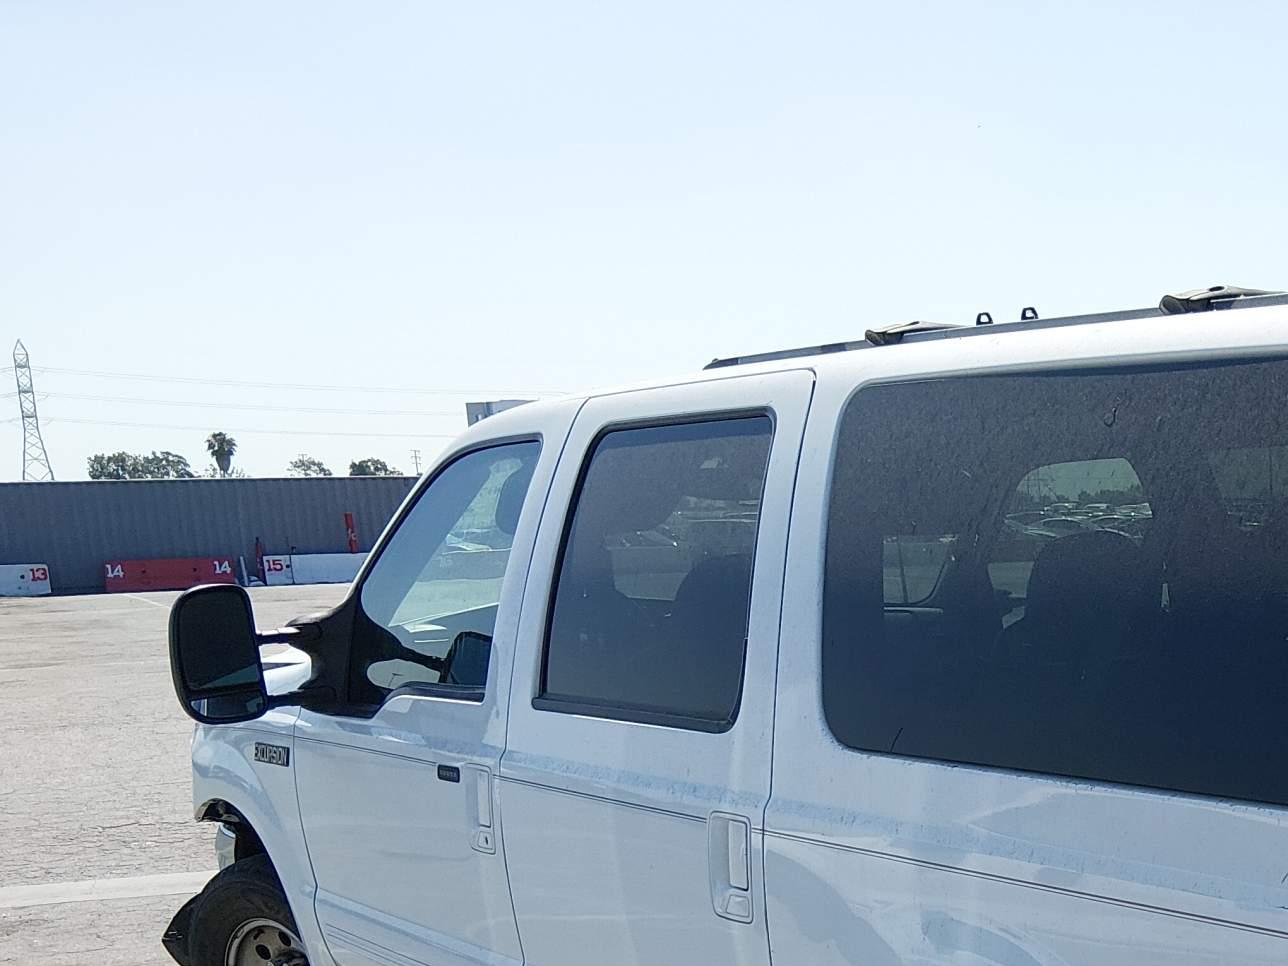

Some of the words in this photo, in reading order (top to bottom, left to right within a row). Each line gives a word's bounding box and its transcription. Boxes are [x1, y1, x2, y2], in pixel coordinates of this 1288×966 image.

[105, 564, 124, 578] 14
[213, 561, 231, 574] 14
[266, 559, 283, 572] 15
[29, 567, 48, 581] 13
